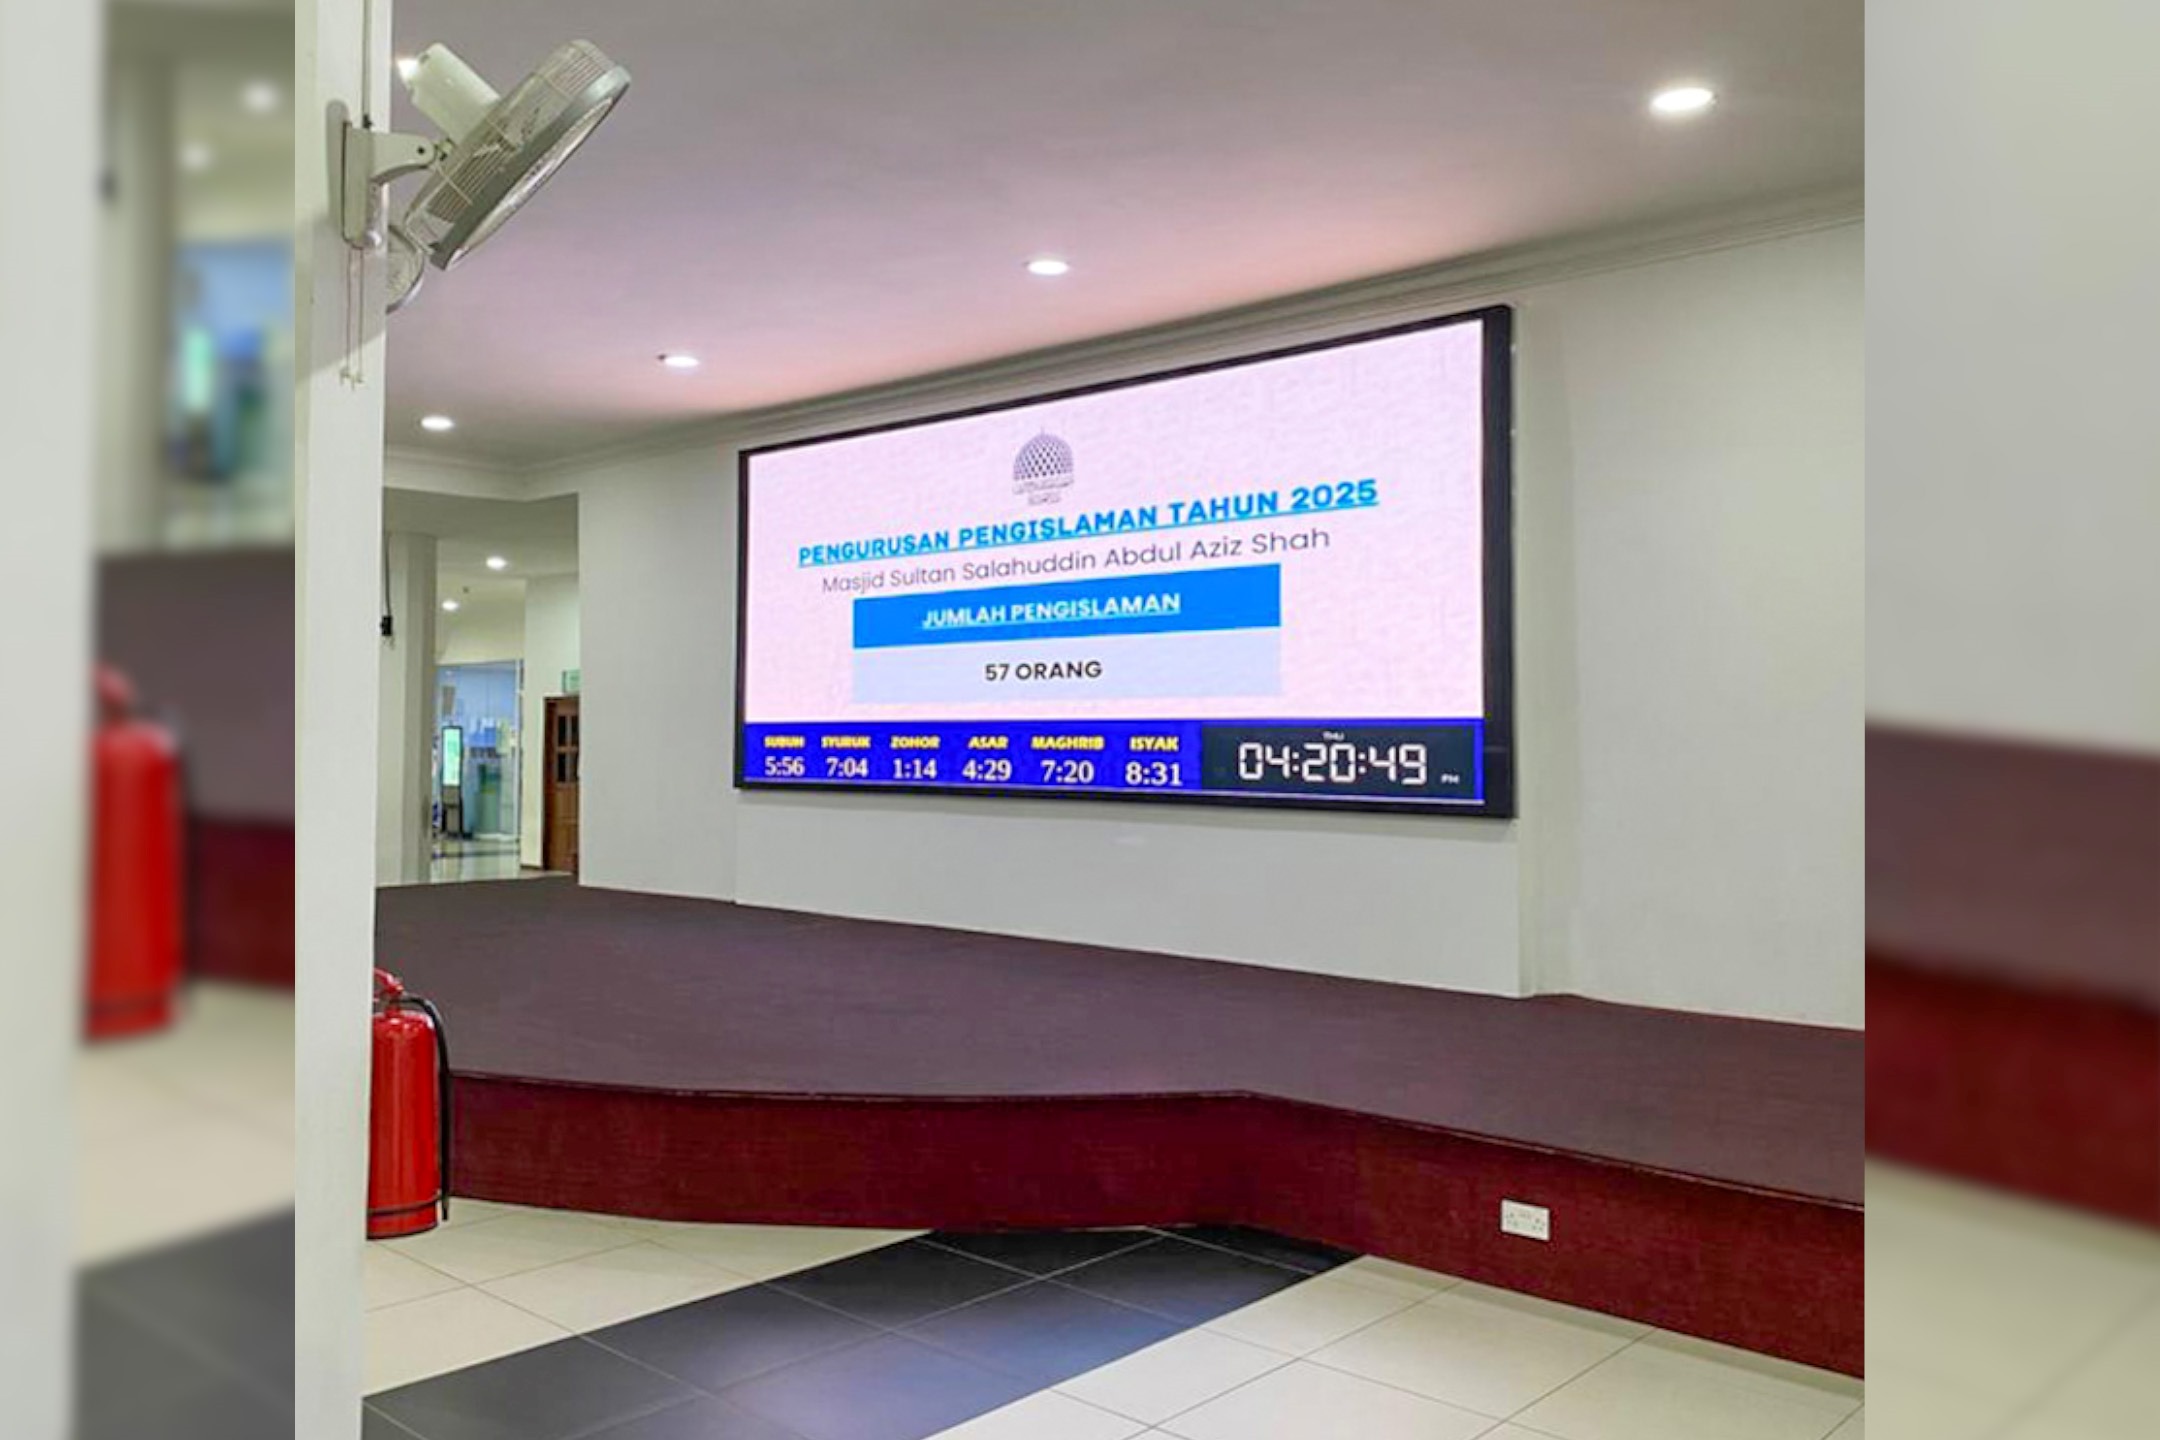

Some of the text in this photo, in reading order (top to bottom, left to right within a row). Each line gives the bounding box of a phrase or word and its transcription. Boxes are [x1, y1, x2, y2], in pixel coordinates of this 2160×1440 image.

[799, 478, 1378, 565] PENGURUSAN PENGISLAMAN TAHUN 2025
[822, 528, 1330, 594] Masjid Sultan Salahuddin Abdul Aziz Shah
[922, 593, 1181, 628] JUMLAH PENGISLAMAN
[985, 660, 1103, 682] 57 ORANG
[968, 736, 1008, 749] ASAR
[1031, 736, 1105, 750] MAGHRIB
[1129, 736, 1179, 751] ISYAK
[764, 756, 805, 776] 5:56
[826, 757, 868, 777] 7:04
[893, 758, 937, 779] 1:14
[962, 759, 1012, 781] 4:29
[1041, 760, 1094, 783] 7:20
[1125, 761, 1182, 786] 8:31
[1239, 742, 1428, 785] 04:20:49
[1441, 774, 1460, 785] PM
